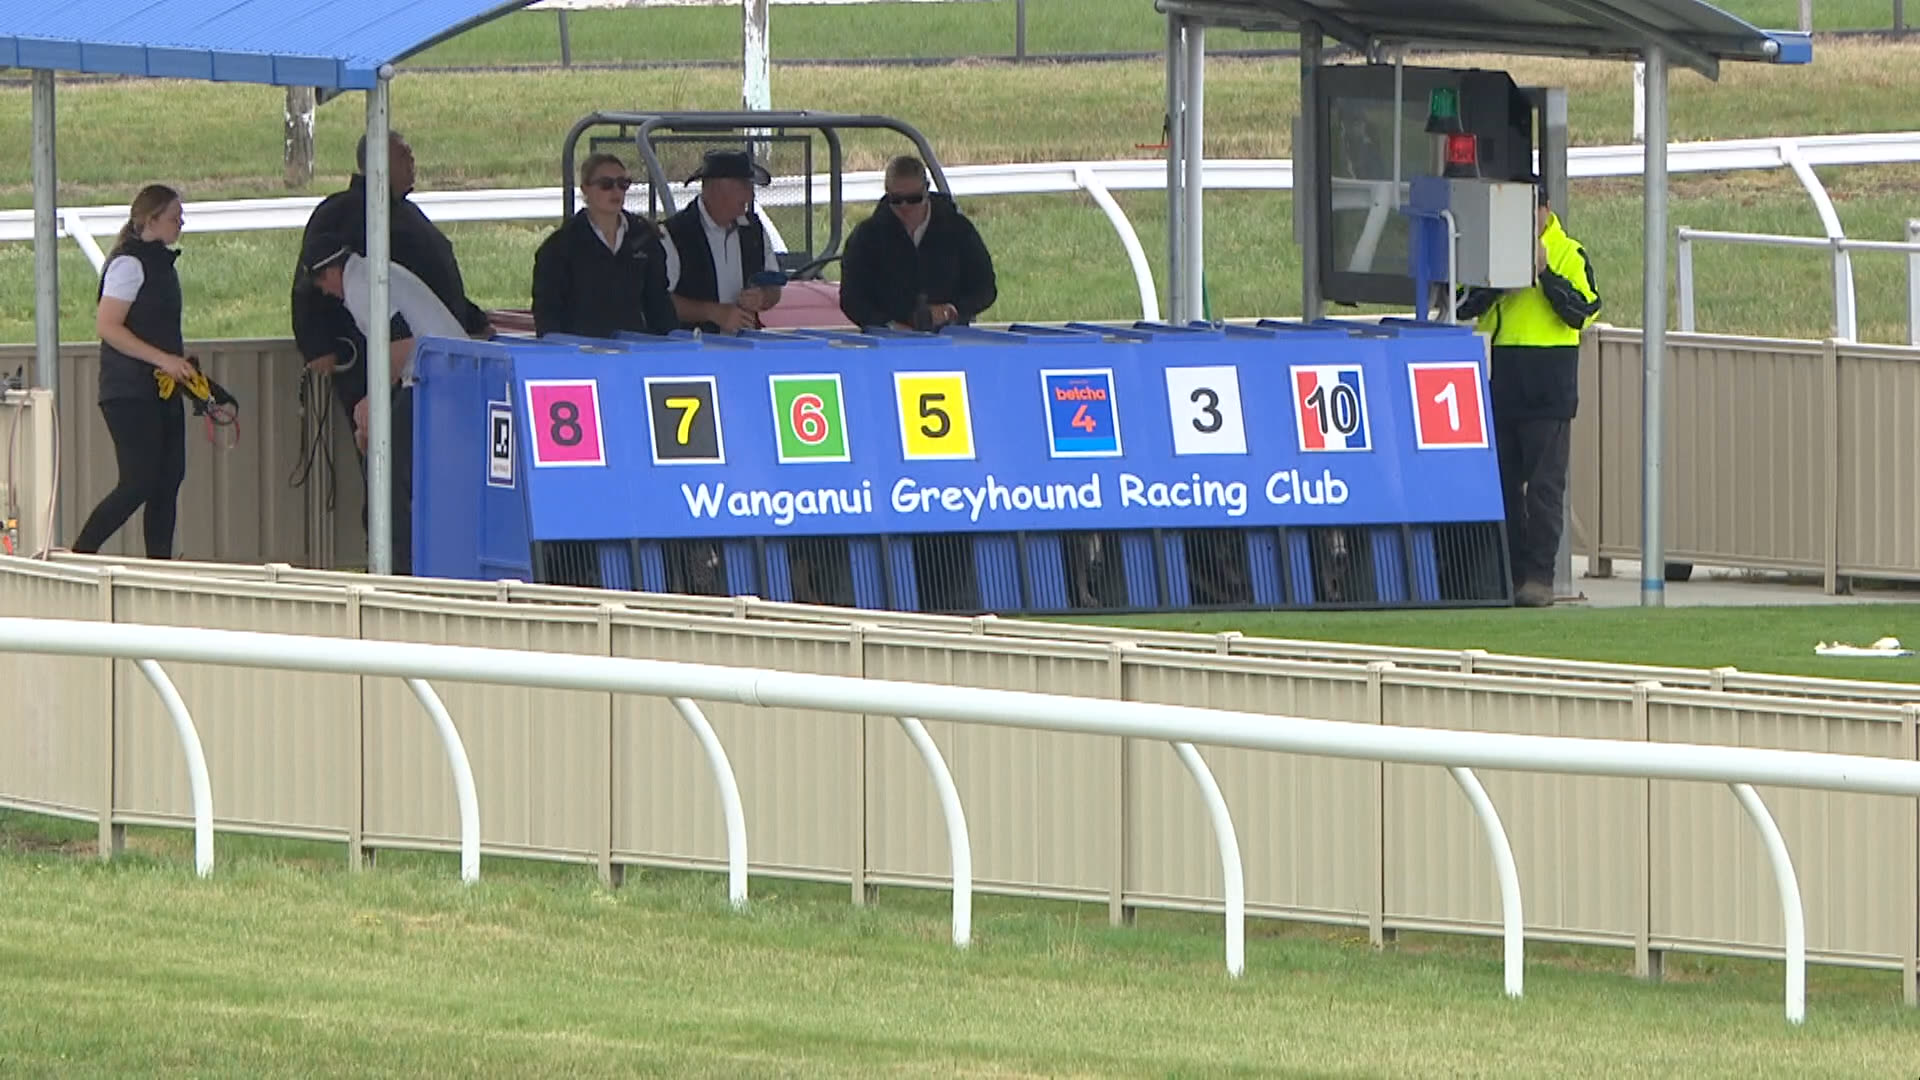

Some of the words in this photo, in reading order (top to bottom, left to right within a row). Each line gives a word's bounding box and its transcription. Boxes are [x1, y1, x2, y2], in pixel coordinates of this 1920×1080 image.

[919, 393, 952, 439] 5
[1055, 385, 1107, 401] betcha
[1189, 387, 1223, 434] 3
[1305, 383, 1359, 435] 10
[1433, 381, 1461, 432] 1
[549, 400, 584, 447] 8
[664, 396, 701, 445] 7
[789, 393, 829, 445] 6
[1071, 403, 1097, 433] 4
[681, 480, 873, 525] Wanganui
[892, 474, 1102, 522] Greyhound
[1119, 471, 1248, 517] Racing
[1265, 469, 1349, 506] Club
